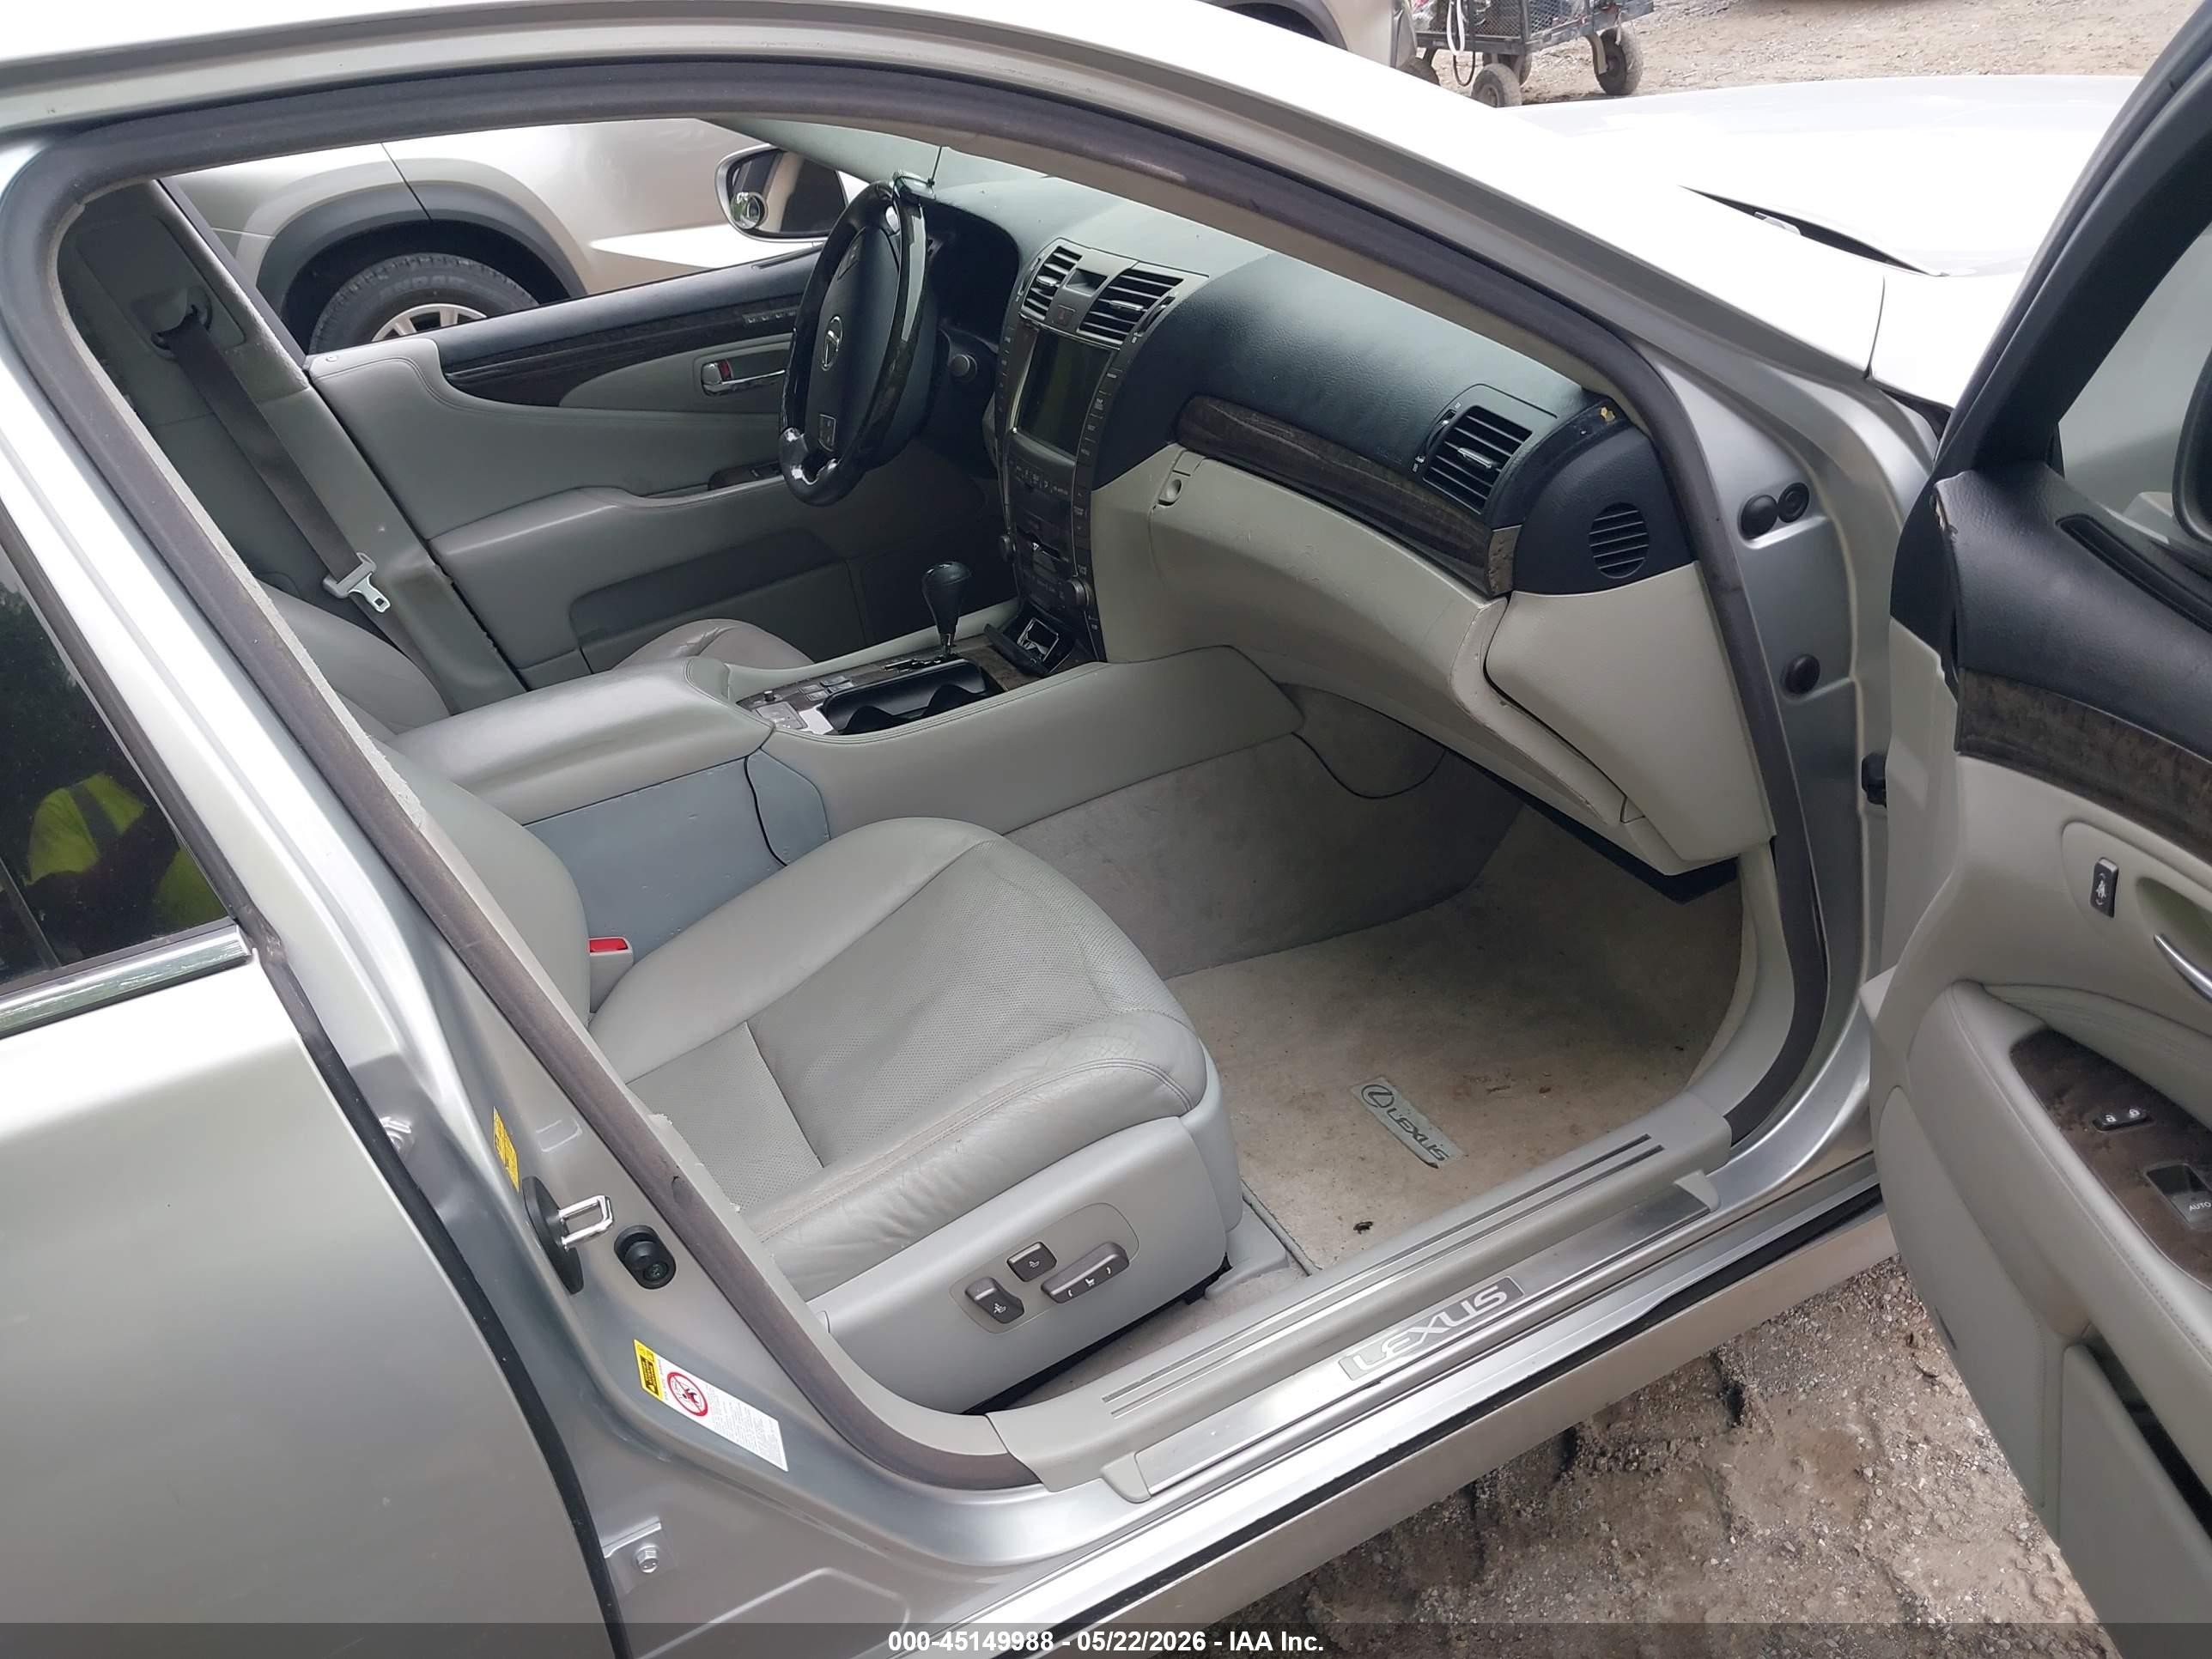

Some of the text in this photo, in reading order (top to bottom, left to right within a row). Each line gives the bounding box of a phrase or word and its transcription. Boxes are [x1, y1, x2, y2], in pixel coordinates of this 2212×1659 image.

[1386, 1107, 1449, 1162] LEXUS
[2189, 1201, 2212, 1212] AUTO
[1352, 1285, 1508, 1371] LEXUS
